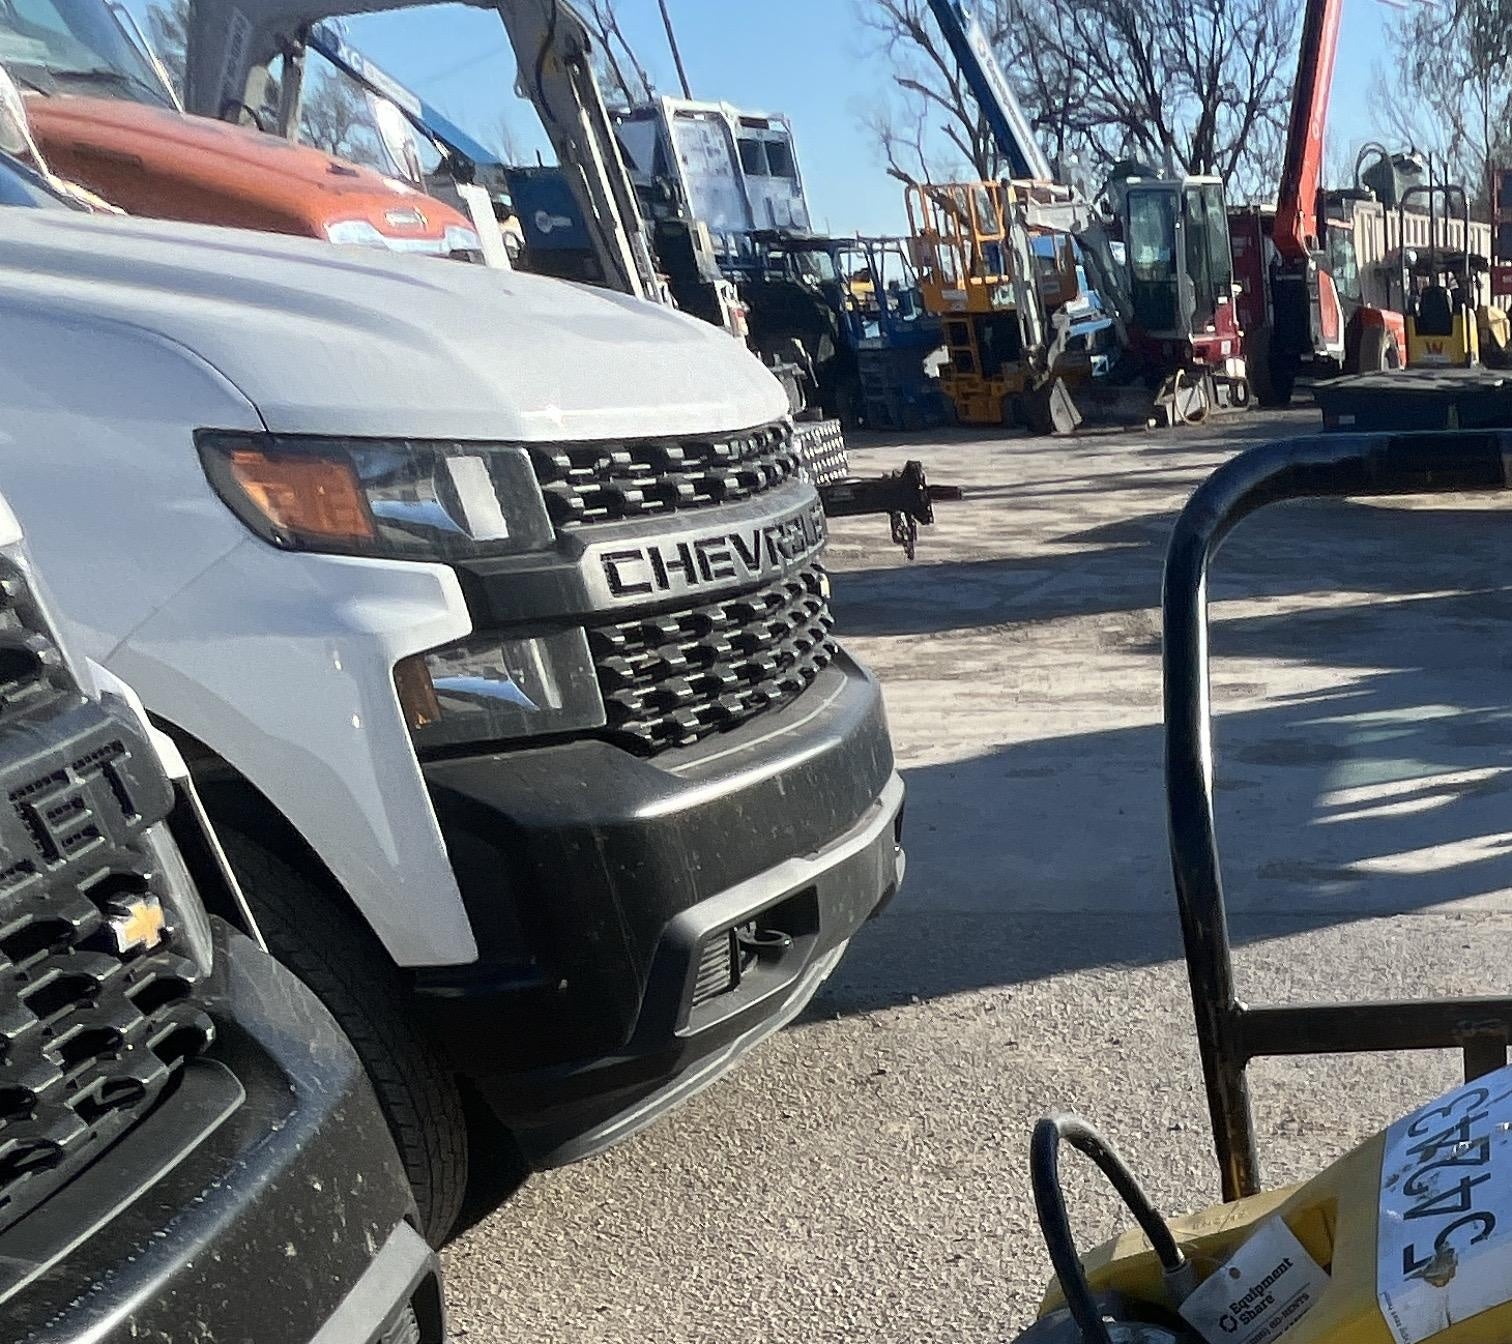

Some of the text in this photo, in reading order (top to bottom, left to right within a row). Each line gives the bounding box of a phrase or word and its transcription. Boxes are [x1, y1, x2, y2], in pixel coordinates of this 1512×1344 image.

[1402, 1087, 1497, 1276] 54243
[1228, 1257, 1294, 1316] Equipment
[1239, 1294, 1276, 1325] Share
